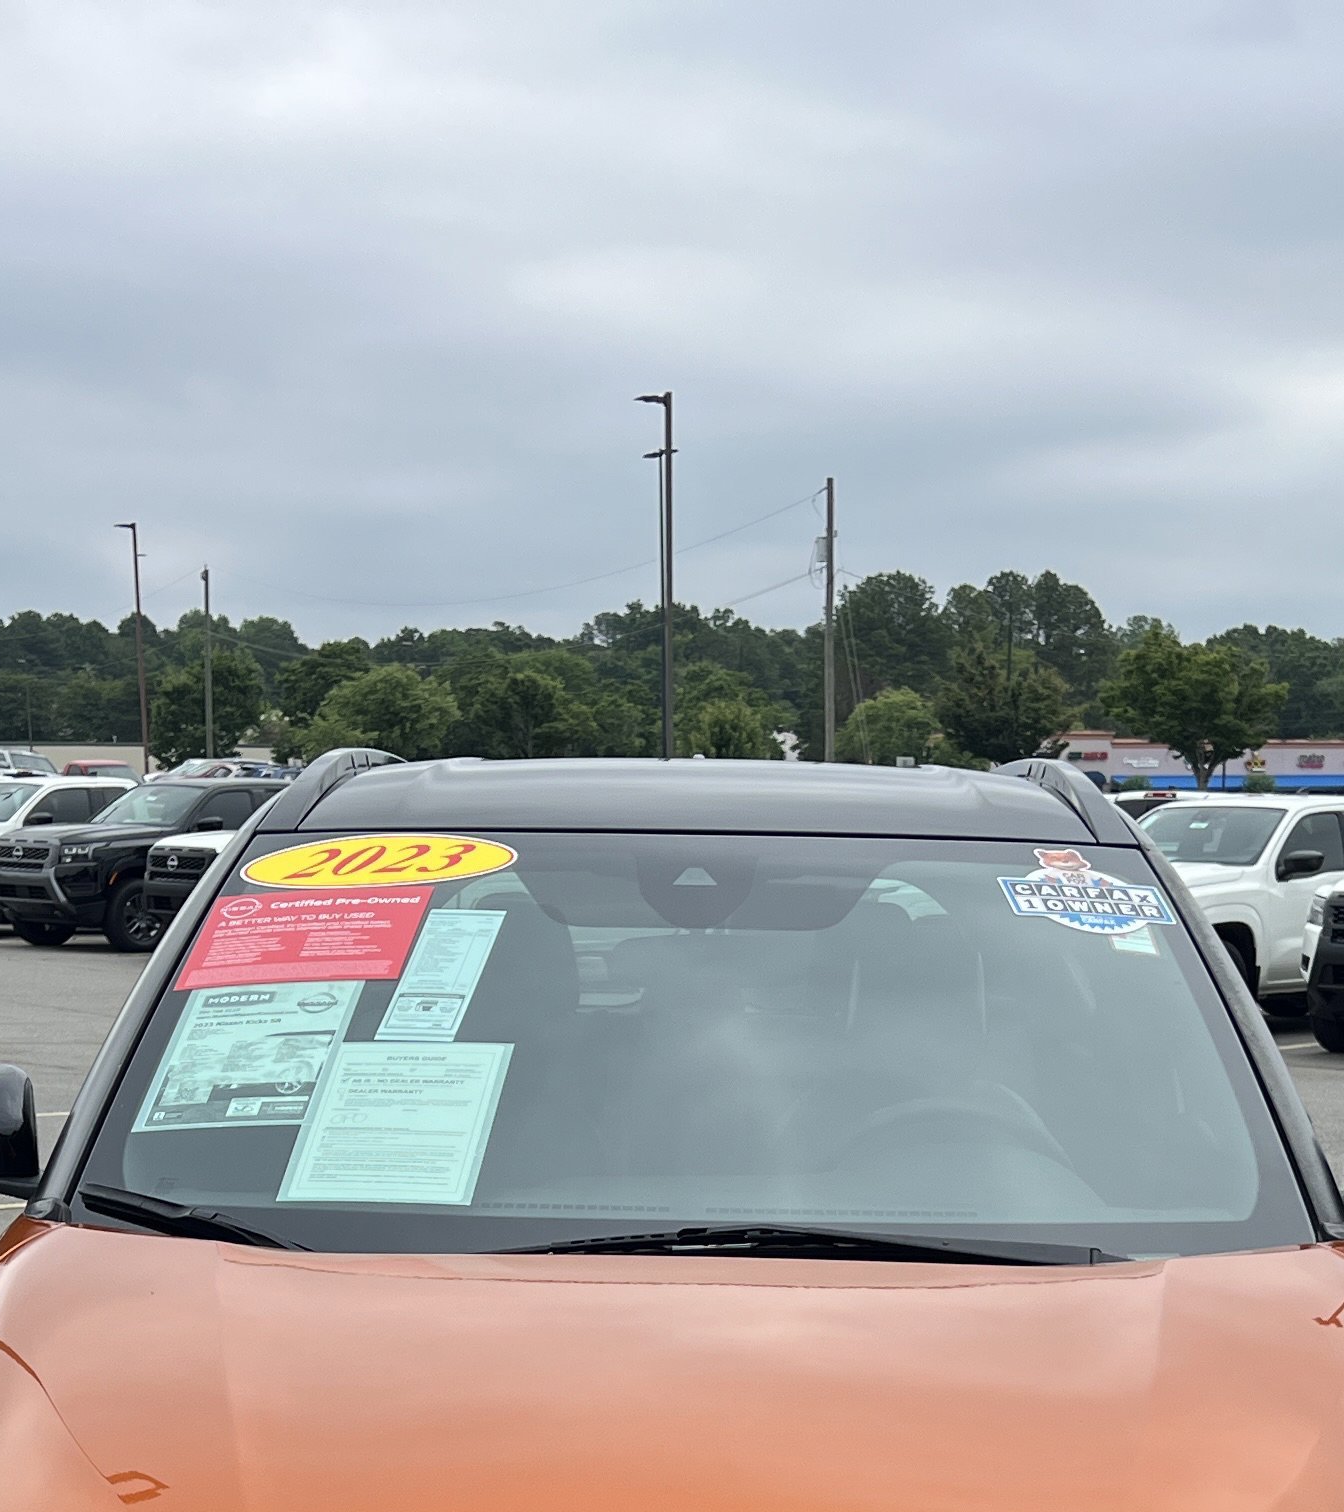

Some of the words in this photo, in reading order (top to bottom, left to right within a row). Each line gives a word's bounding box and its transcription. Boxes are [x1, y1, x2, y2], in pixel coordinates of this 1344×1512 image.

[281, 844, 476, 880] 2023
[270, 897, 332, 910] Certified
[335, 895, 421, 906] Pre-Owned
[1015, 884, 1152, 904] CARFAX
[1023, 899, 1038, 909] 1
[1046, 899, 1161, 918] OWNER
[228, 917, 272, 926] BETTER
[273, 914, 298, 922] WAY
[301, 913, 316, 921] TO
[318, 912, 343, 921] BUY
[344, 911, 375, 919] USED
[207, 993, 271, 1005] MODERN
